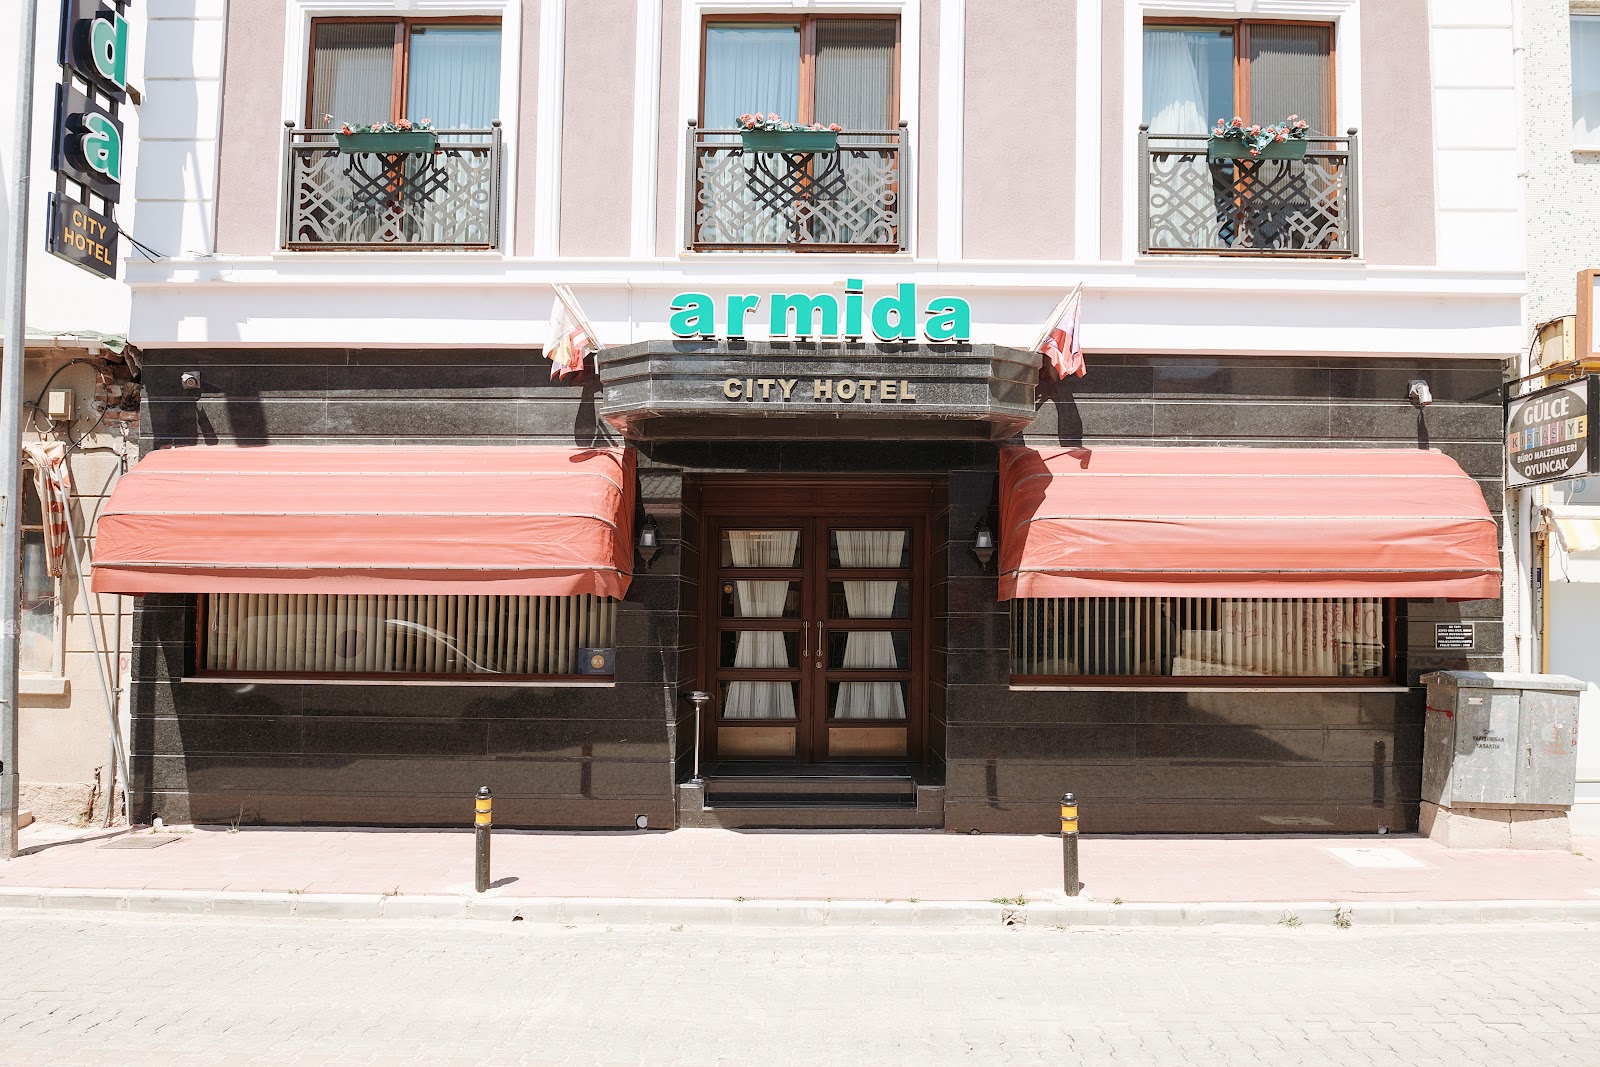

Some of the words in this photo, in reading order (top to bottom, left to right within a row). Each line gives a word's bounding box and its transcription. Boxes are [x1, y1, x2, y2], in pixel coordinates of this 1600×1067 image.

[72, 209, 107, 240] CITY
[63, 226, 112, 266] HOTEL
[669, 278, 972, 342] armida
[723, 378, 798, 401] CITY
[813, 379, 916, 403] HOTEL
[1523, 396, 1570, 426] GÜLCE
[1517, 452, 1533, 464] BÜRO
[1534, 441, 1578, 460] MALZEMELERİ
[1524, 457, 1569, 477] OYUNCAK
